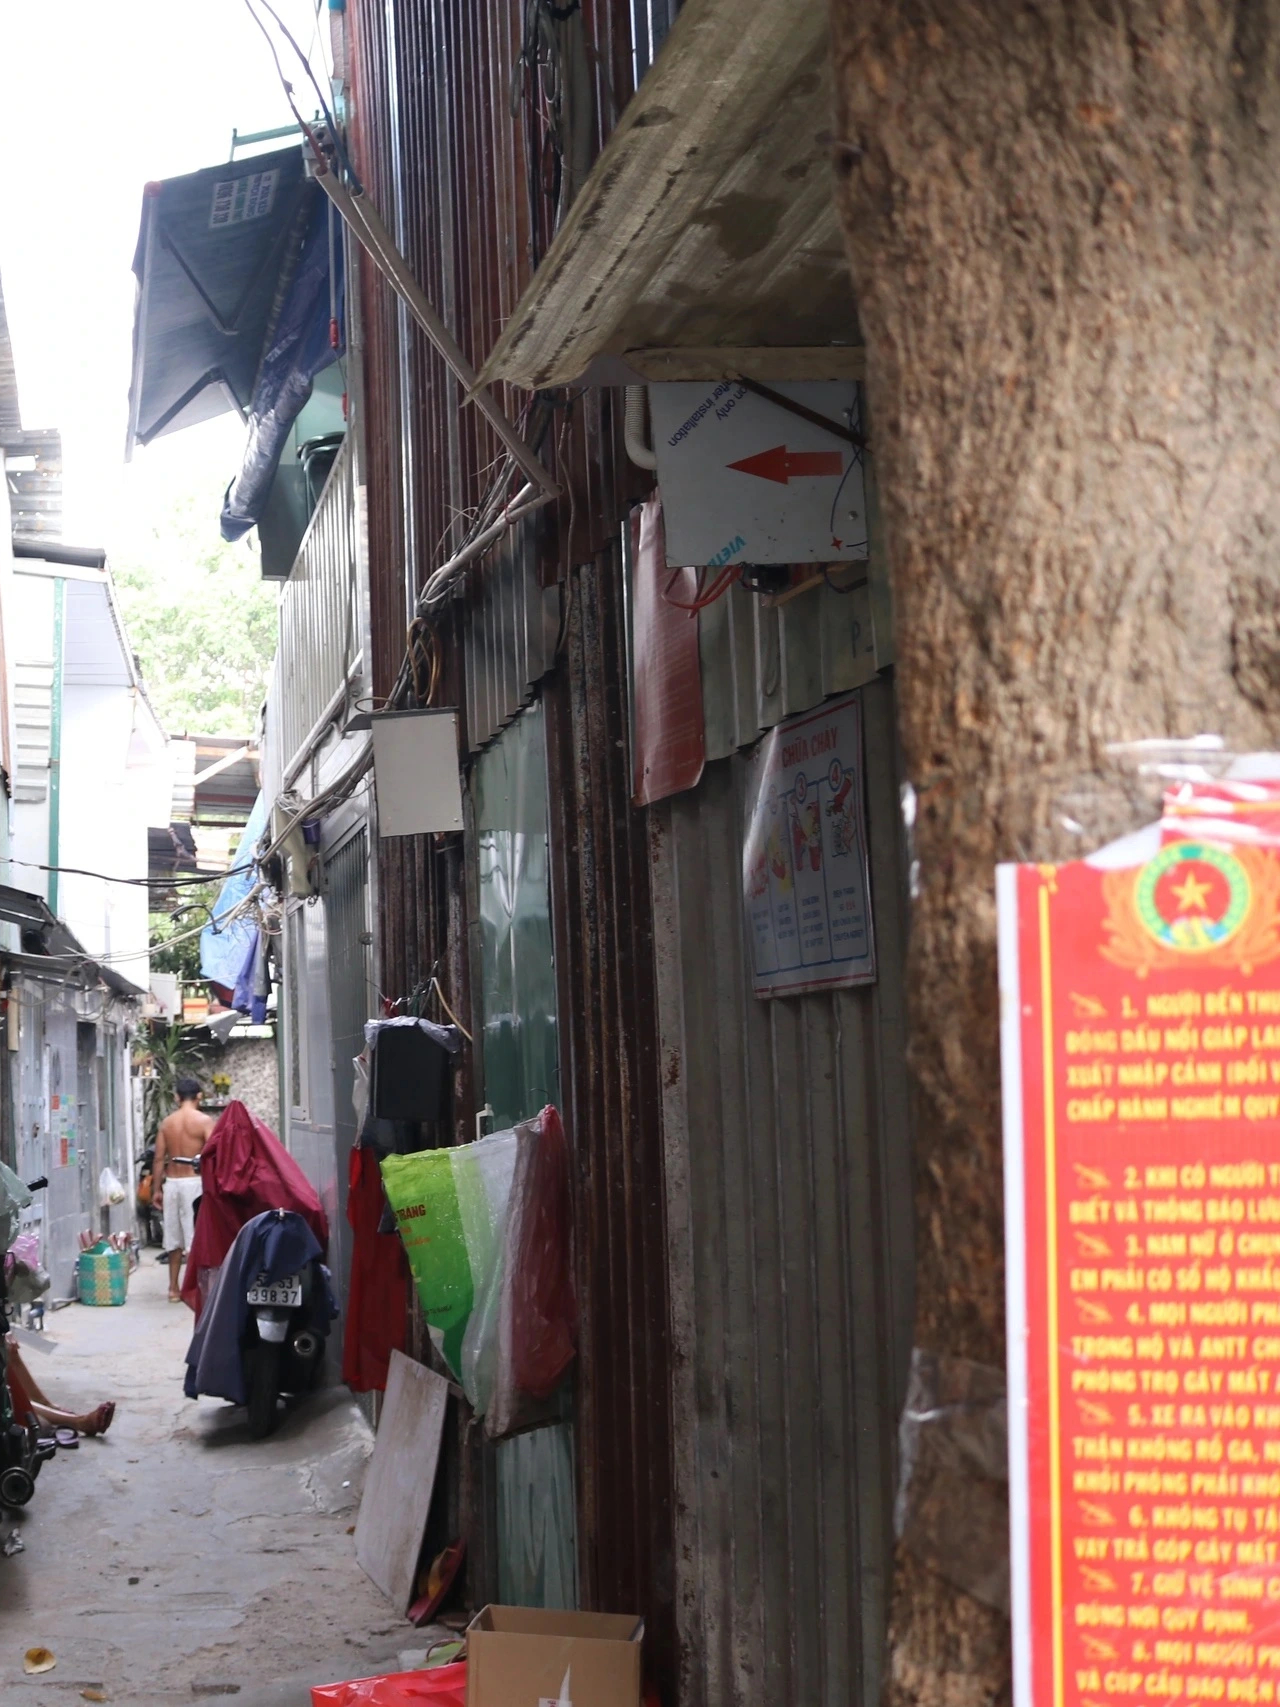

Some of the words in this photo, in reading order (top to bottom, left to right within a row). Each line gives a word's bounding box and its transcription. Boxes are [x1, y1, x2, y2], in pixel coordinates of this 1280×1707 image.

[714, 378, 734, 400] after
[668, 396, 717, 447] installation
[715, 399, 737, 421] only
[782, 736, 810, 769] CHỮA
[251, 1288, 298, 1305] 398.37
[1253, 1503, 1280, 1533] TẬ
